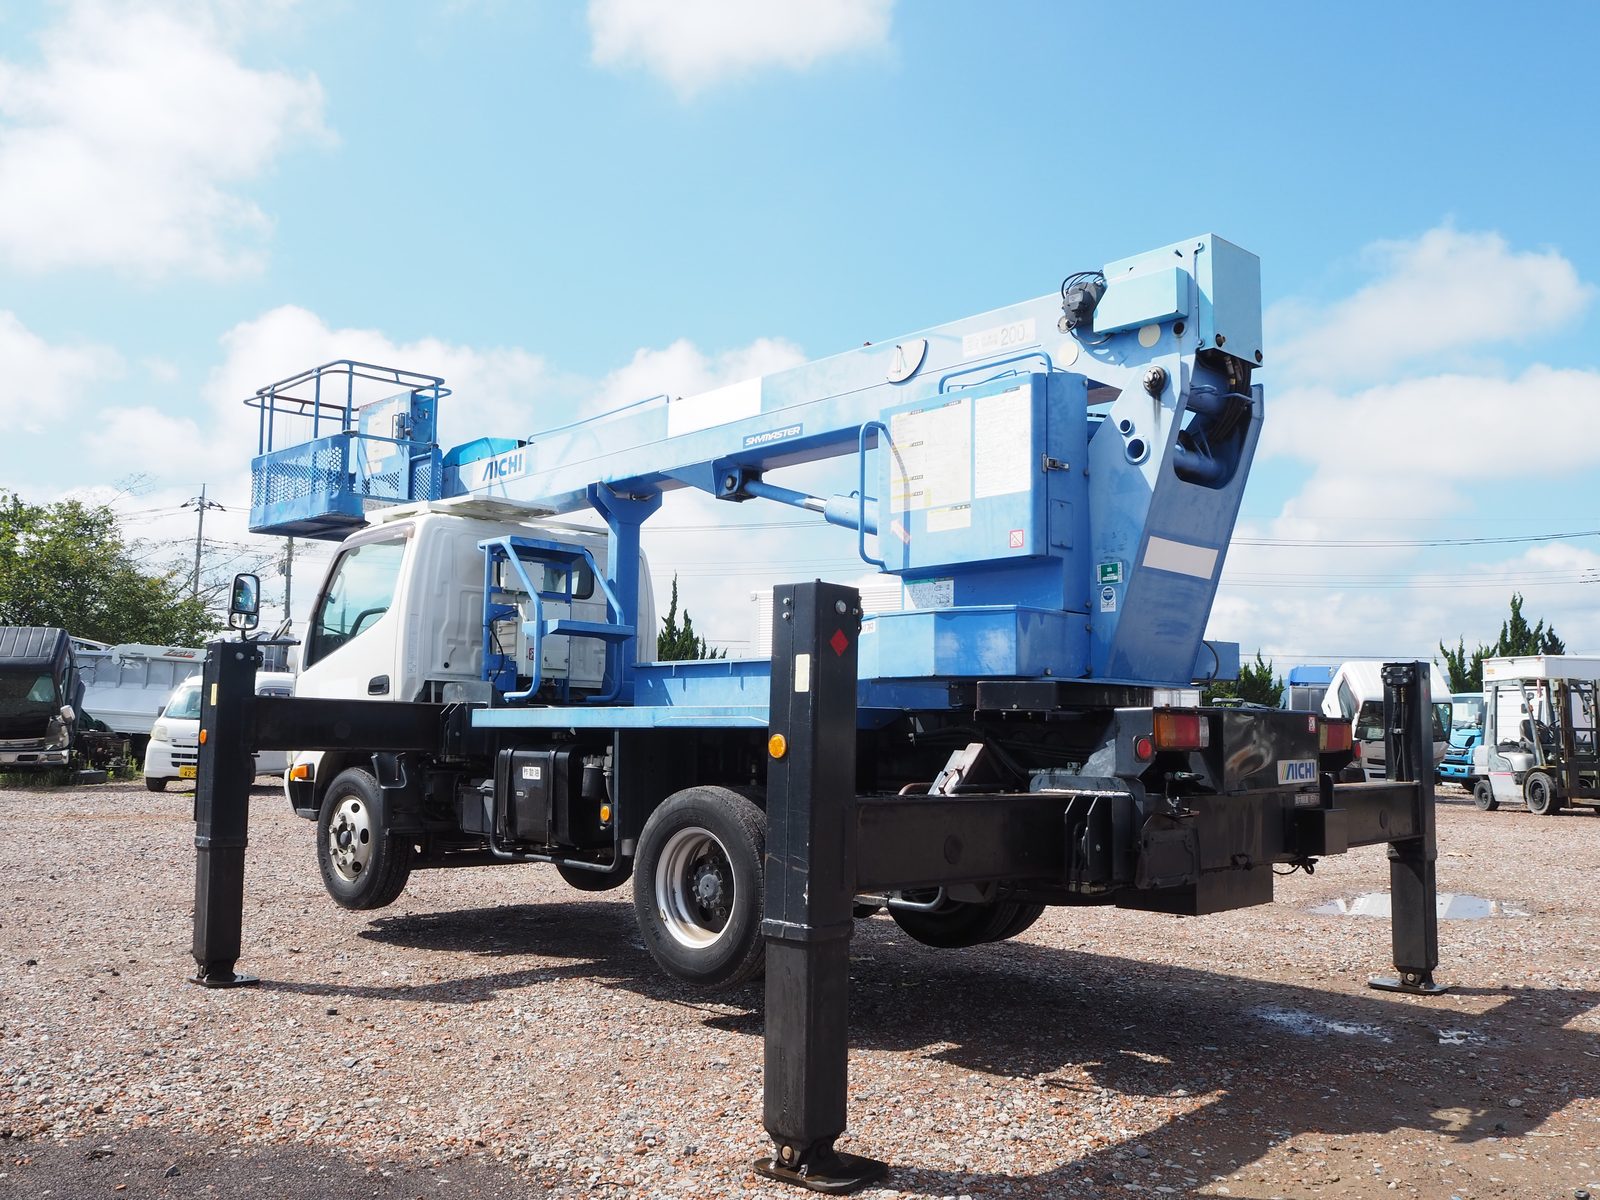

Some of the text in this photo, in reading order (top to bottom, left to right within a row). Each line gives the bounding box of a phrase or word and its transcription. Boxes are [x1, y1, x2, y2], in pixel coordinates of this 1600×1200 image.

[1000, 323, 1026, 346] 200
[482, 453, 523, 482] AICHI
[1286, 762, 1315, 780] AICHI
